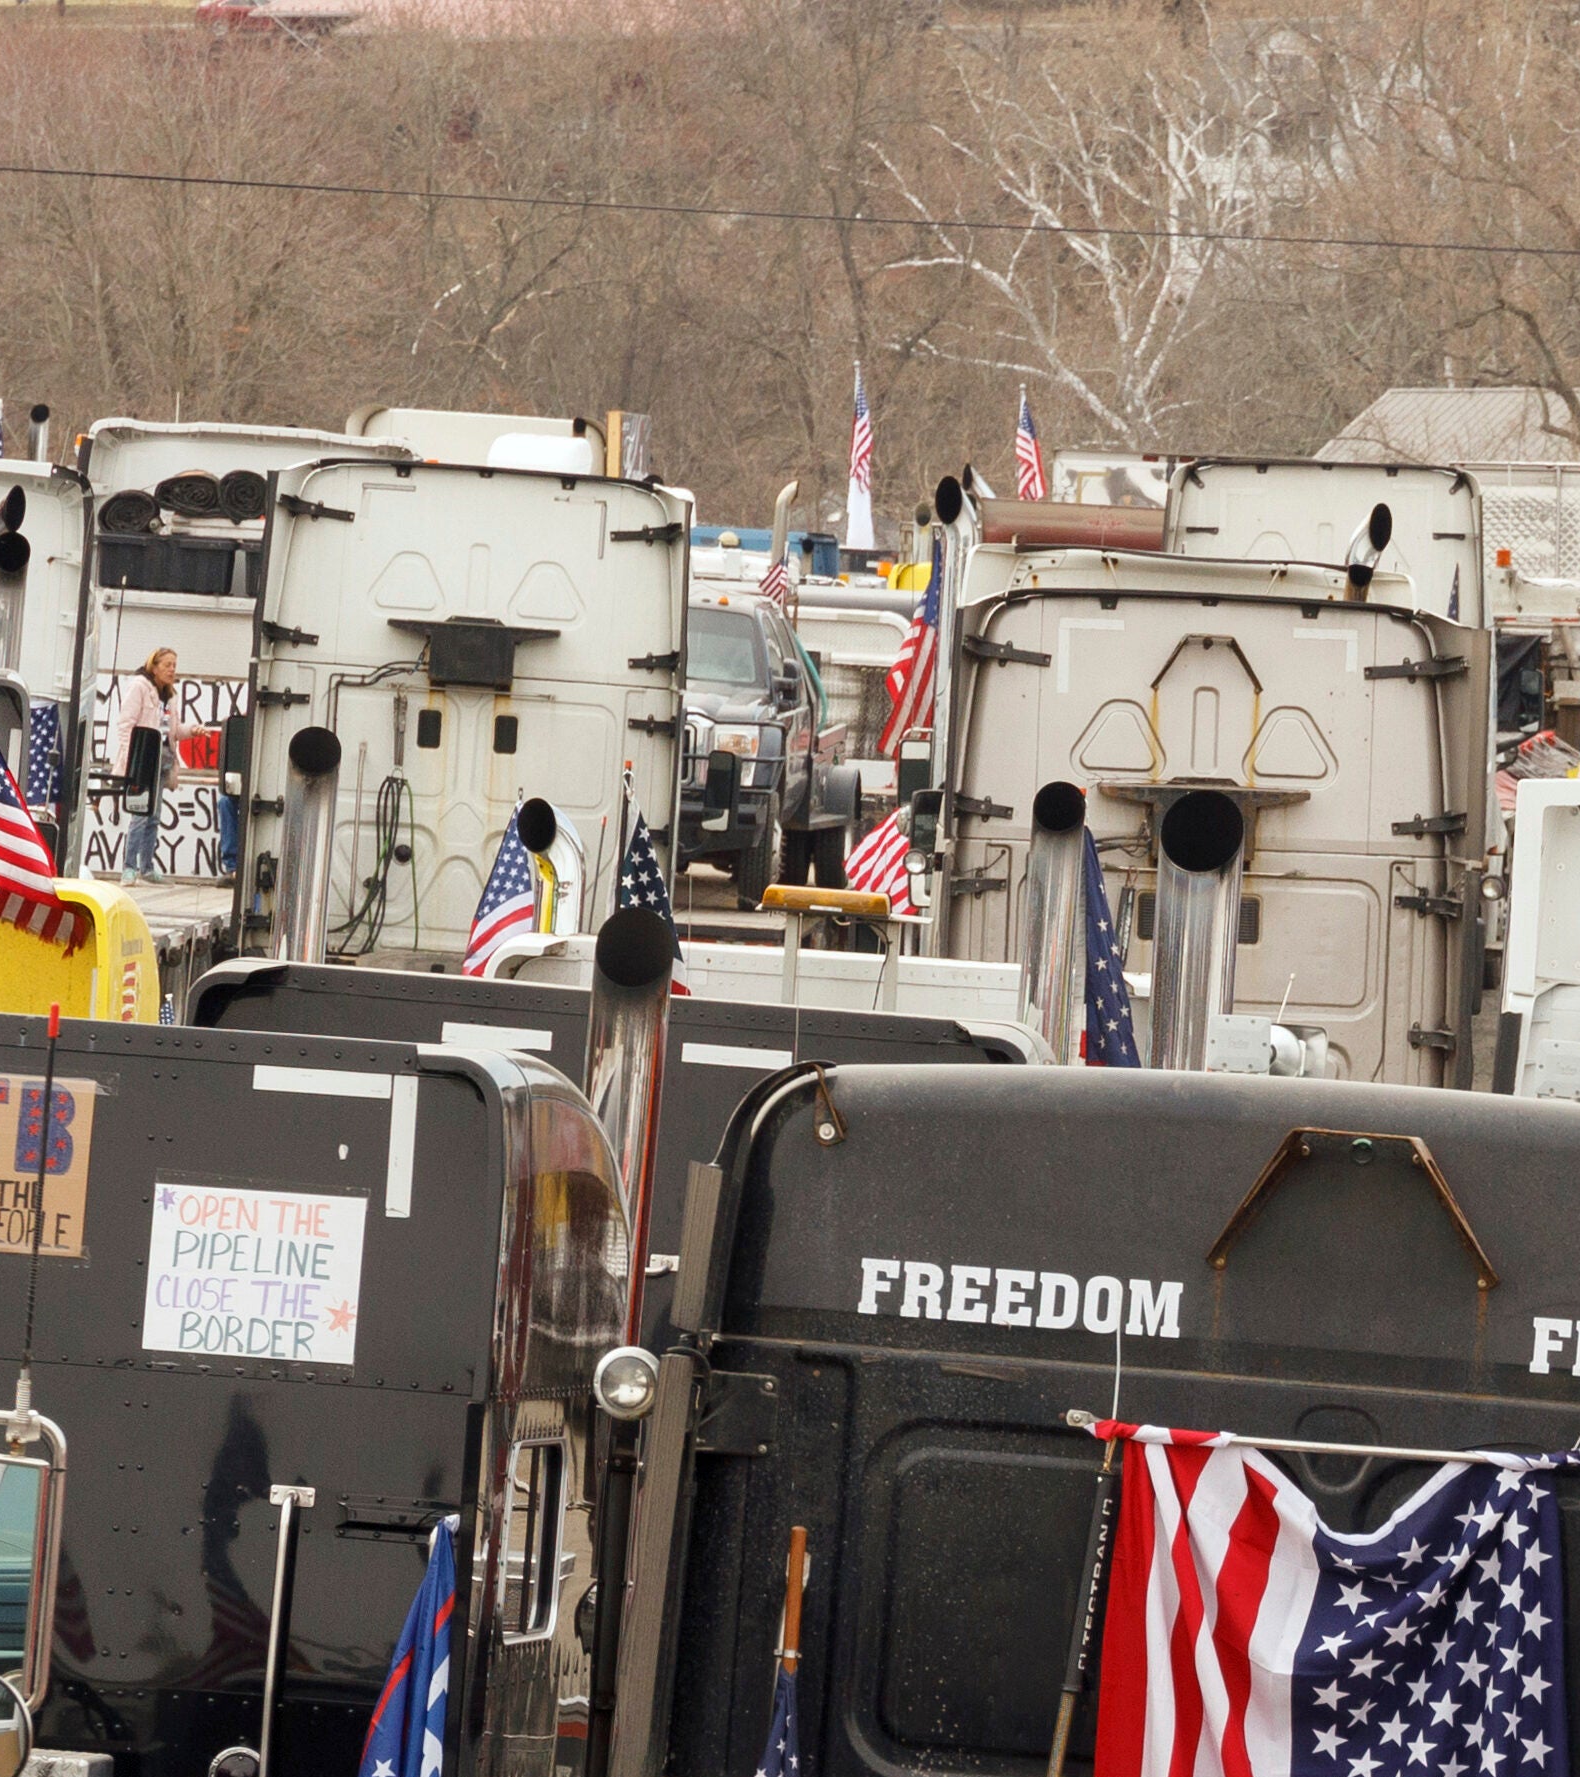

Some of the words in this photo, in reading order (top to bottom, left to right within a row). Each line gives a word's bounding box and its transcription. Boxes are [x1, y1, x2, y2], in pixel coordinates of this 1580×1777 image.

[97, 676, 244, 727] MRIX
[84, 830, 185, 875] AVRY
[179, 1194, 260, 1232] OPEN
[270, 1200, 331, 1238] THE
[172, 1230, 334, 1280] PIPELINE
[155, 1274, 238, 1313] CLOSE
[250, 1280, 321, 1320] THE
[857, 1257, 1185, 1339] FREEDOM
[178, 1311, 315, 1358] BORDER
[1081, 1523, 1109, 1646] TECTRAN
